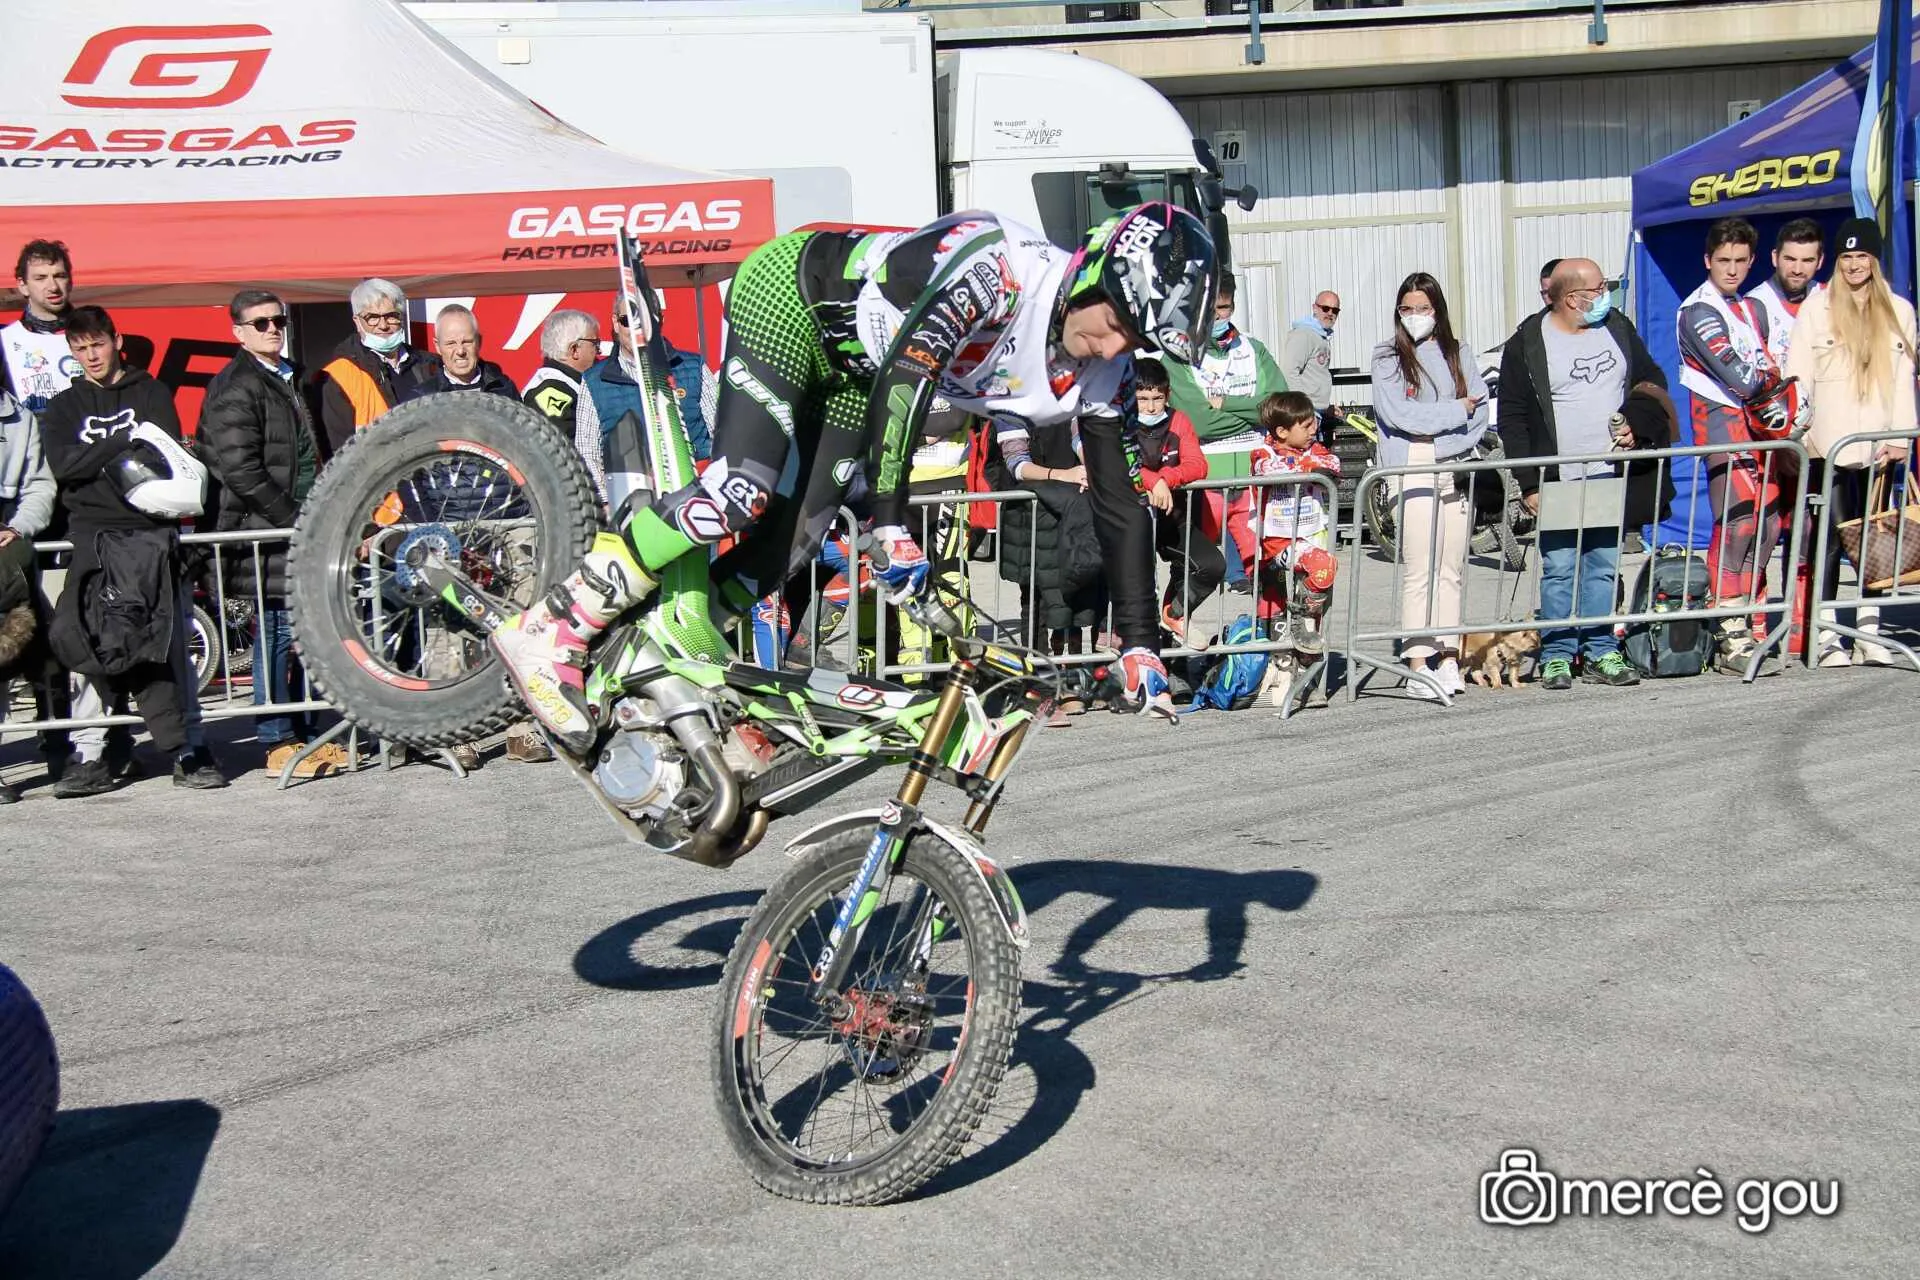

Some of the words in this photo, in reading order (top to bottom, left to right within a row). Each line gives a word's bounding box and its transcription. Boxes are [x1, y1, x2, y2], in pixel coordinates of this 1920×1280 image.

[0, 156, 168, 169] CTORY
[175, 150, 343, 168] RACING
[1222, 141, 1240, 160] 10
[1689, 149, 1841, 208] SHERCO
[508, 199, 743, 240] GASGAS
[839, 833, 882, 923] MICHELIN
